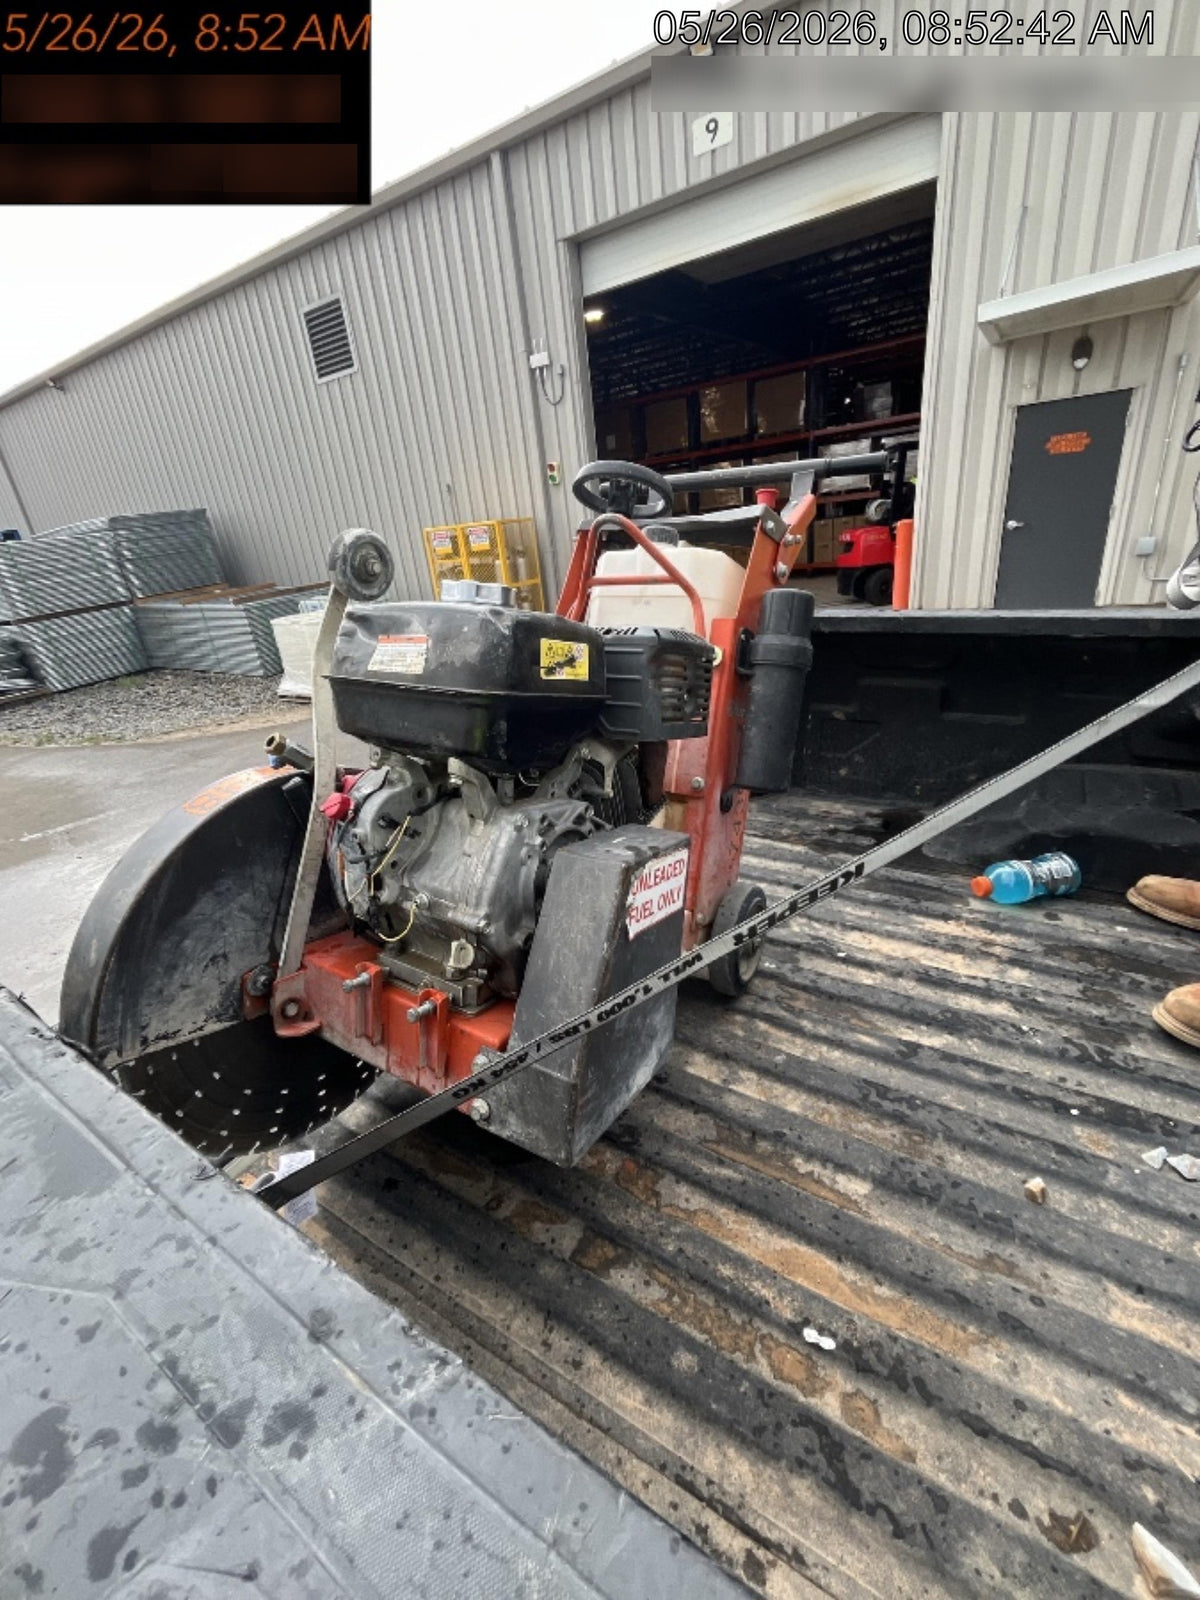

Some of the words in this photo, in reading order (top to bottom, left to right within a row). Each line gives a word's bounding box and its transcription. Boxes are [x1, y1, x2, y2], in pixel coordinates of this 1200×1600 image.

[705, 117, 719, 144] 9
[628, 900, 655, 927] FUEL
[658, 884, 683, 911] ONLY
[732, 862, 865, 946] KEEPER
[597, 984, 653, 1023] 1,000
[490, 1053, 529, 1078] 454
[452, 1079, 486, 1099] KG
